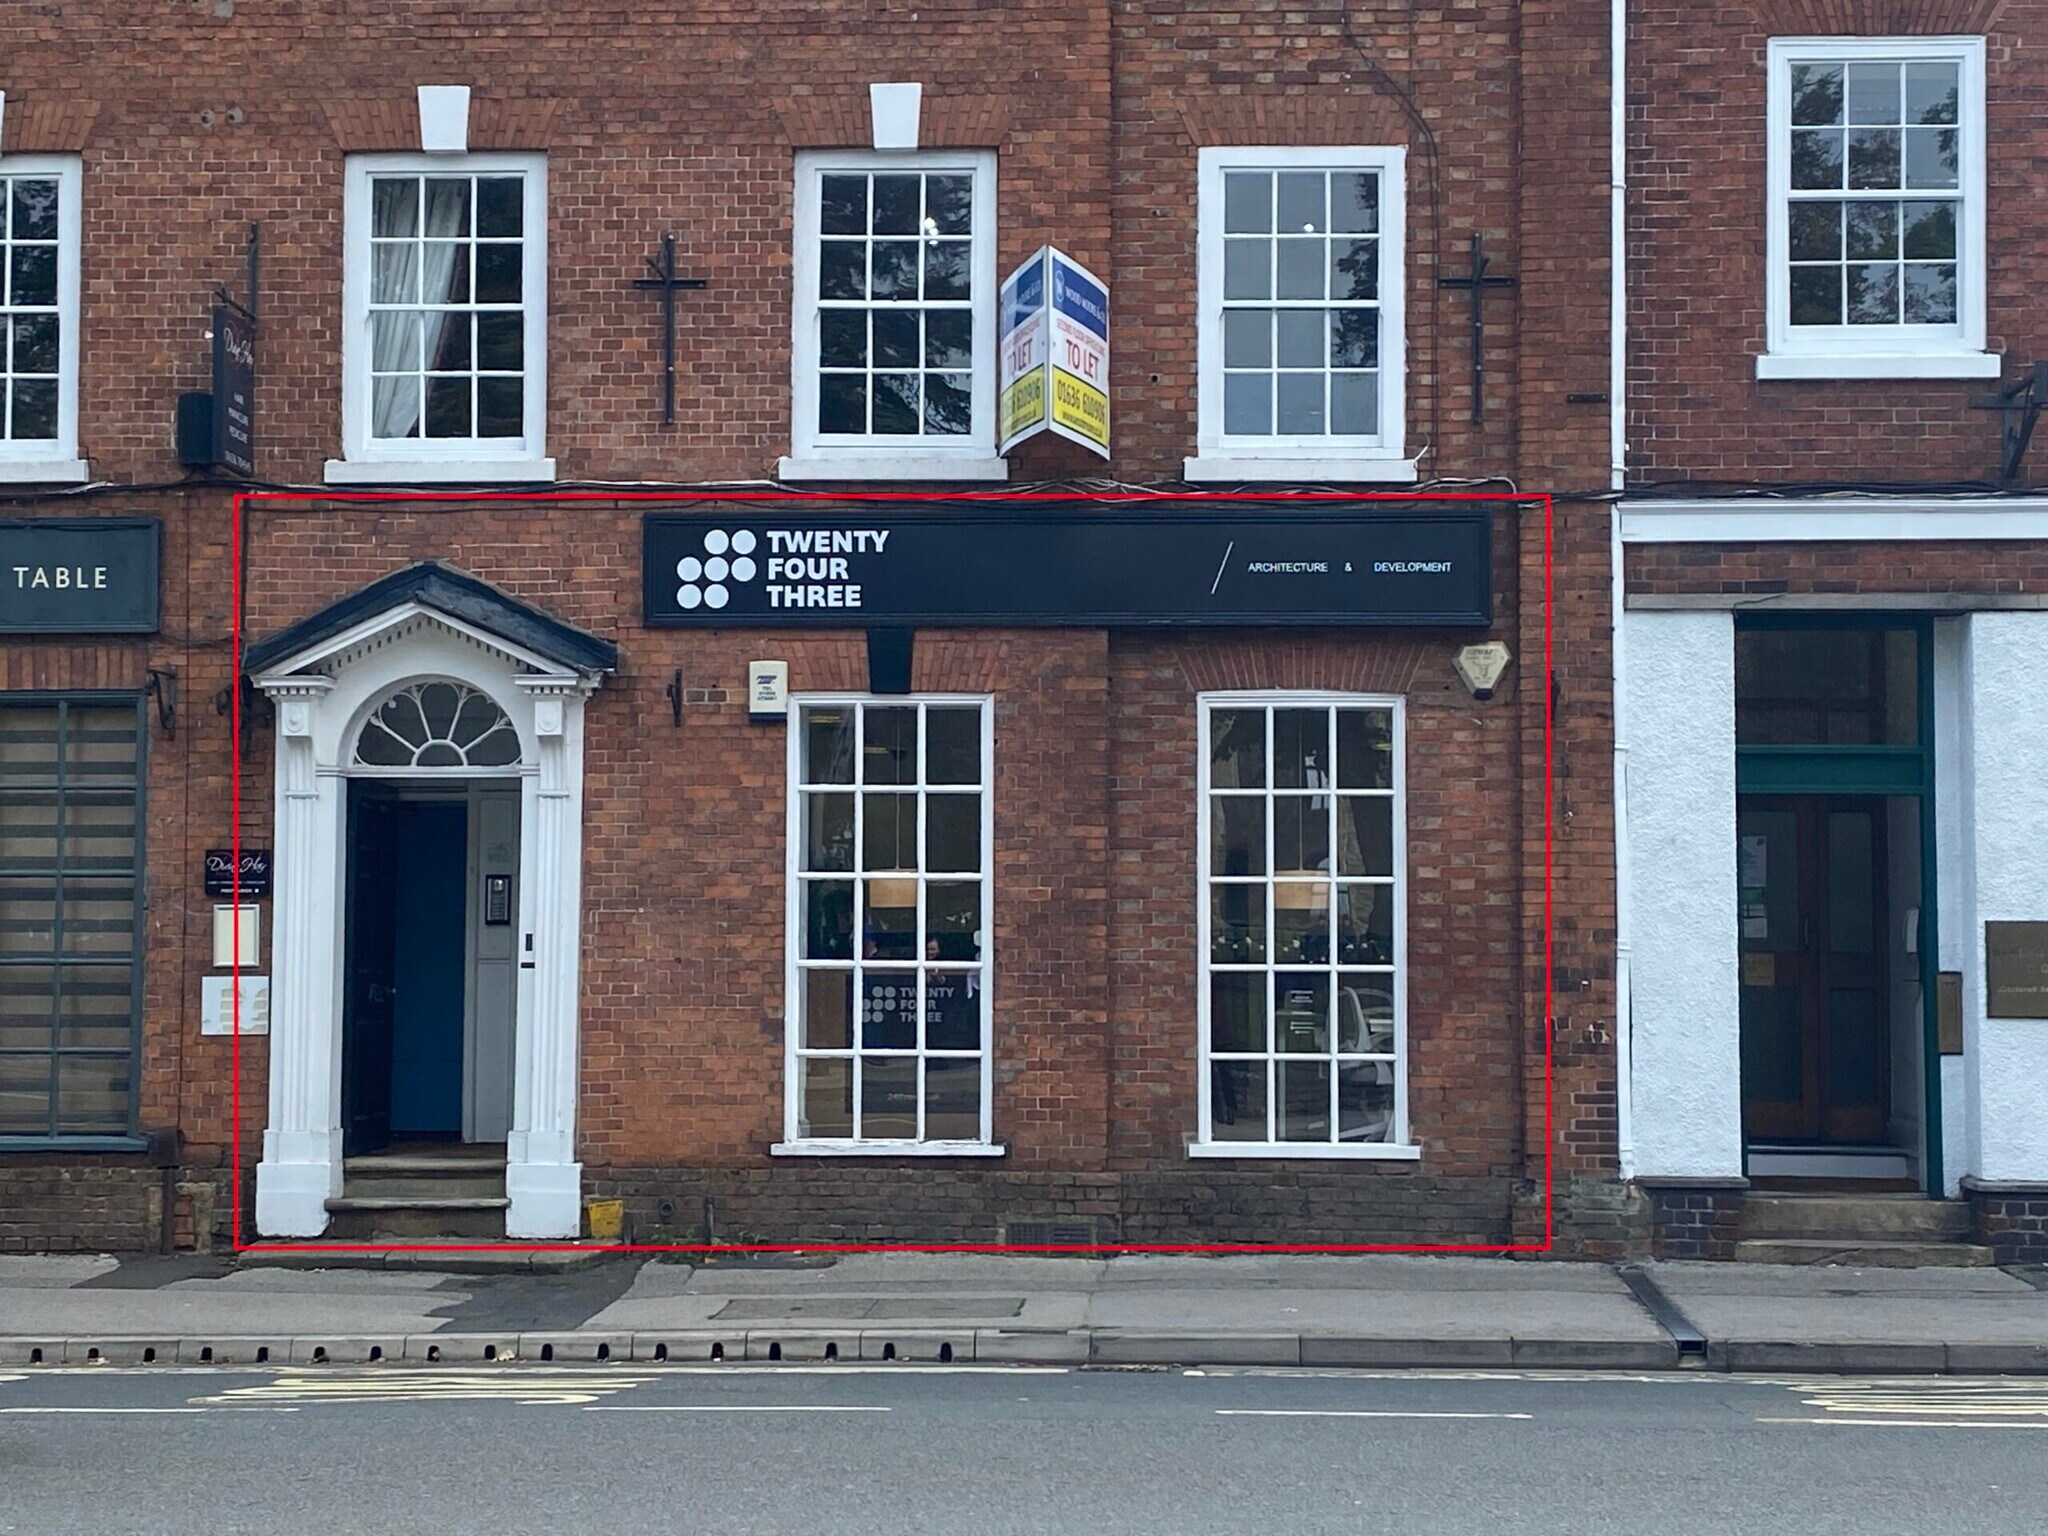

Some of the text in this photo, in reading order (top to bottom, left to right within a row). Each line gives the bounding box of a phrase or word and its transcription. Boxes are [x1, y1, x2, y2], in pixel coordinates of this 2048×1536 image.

[1066, 339, 1100, 381] TO LET
[767, 530, 890, 553] TWENTY
[13, 567, 107, 588] TABLE
[767, 558, 849, 580] FOUR
[1247, 561, 1452, 573] ARCHITECTURE & DEVELOPMENT
[766, 585, 862, 608] THREE
[900, 987, 955, 998] TWNTY
[900, 1000, 937, 1010] FOR
[900, 1012, 943, 1023] THEE
